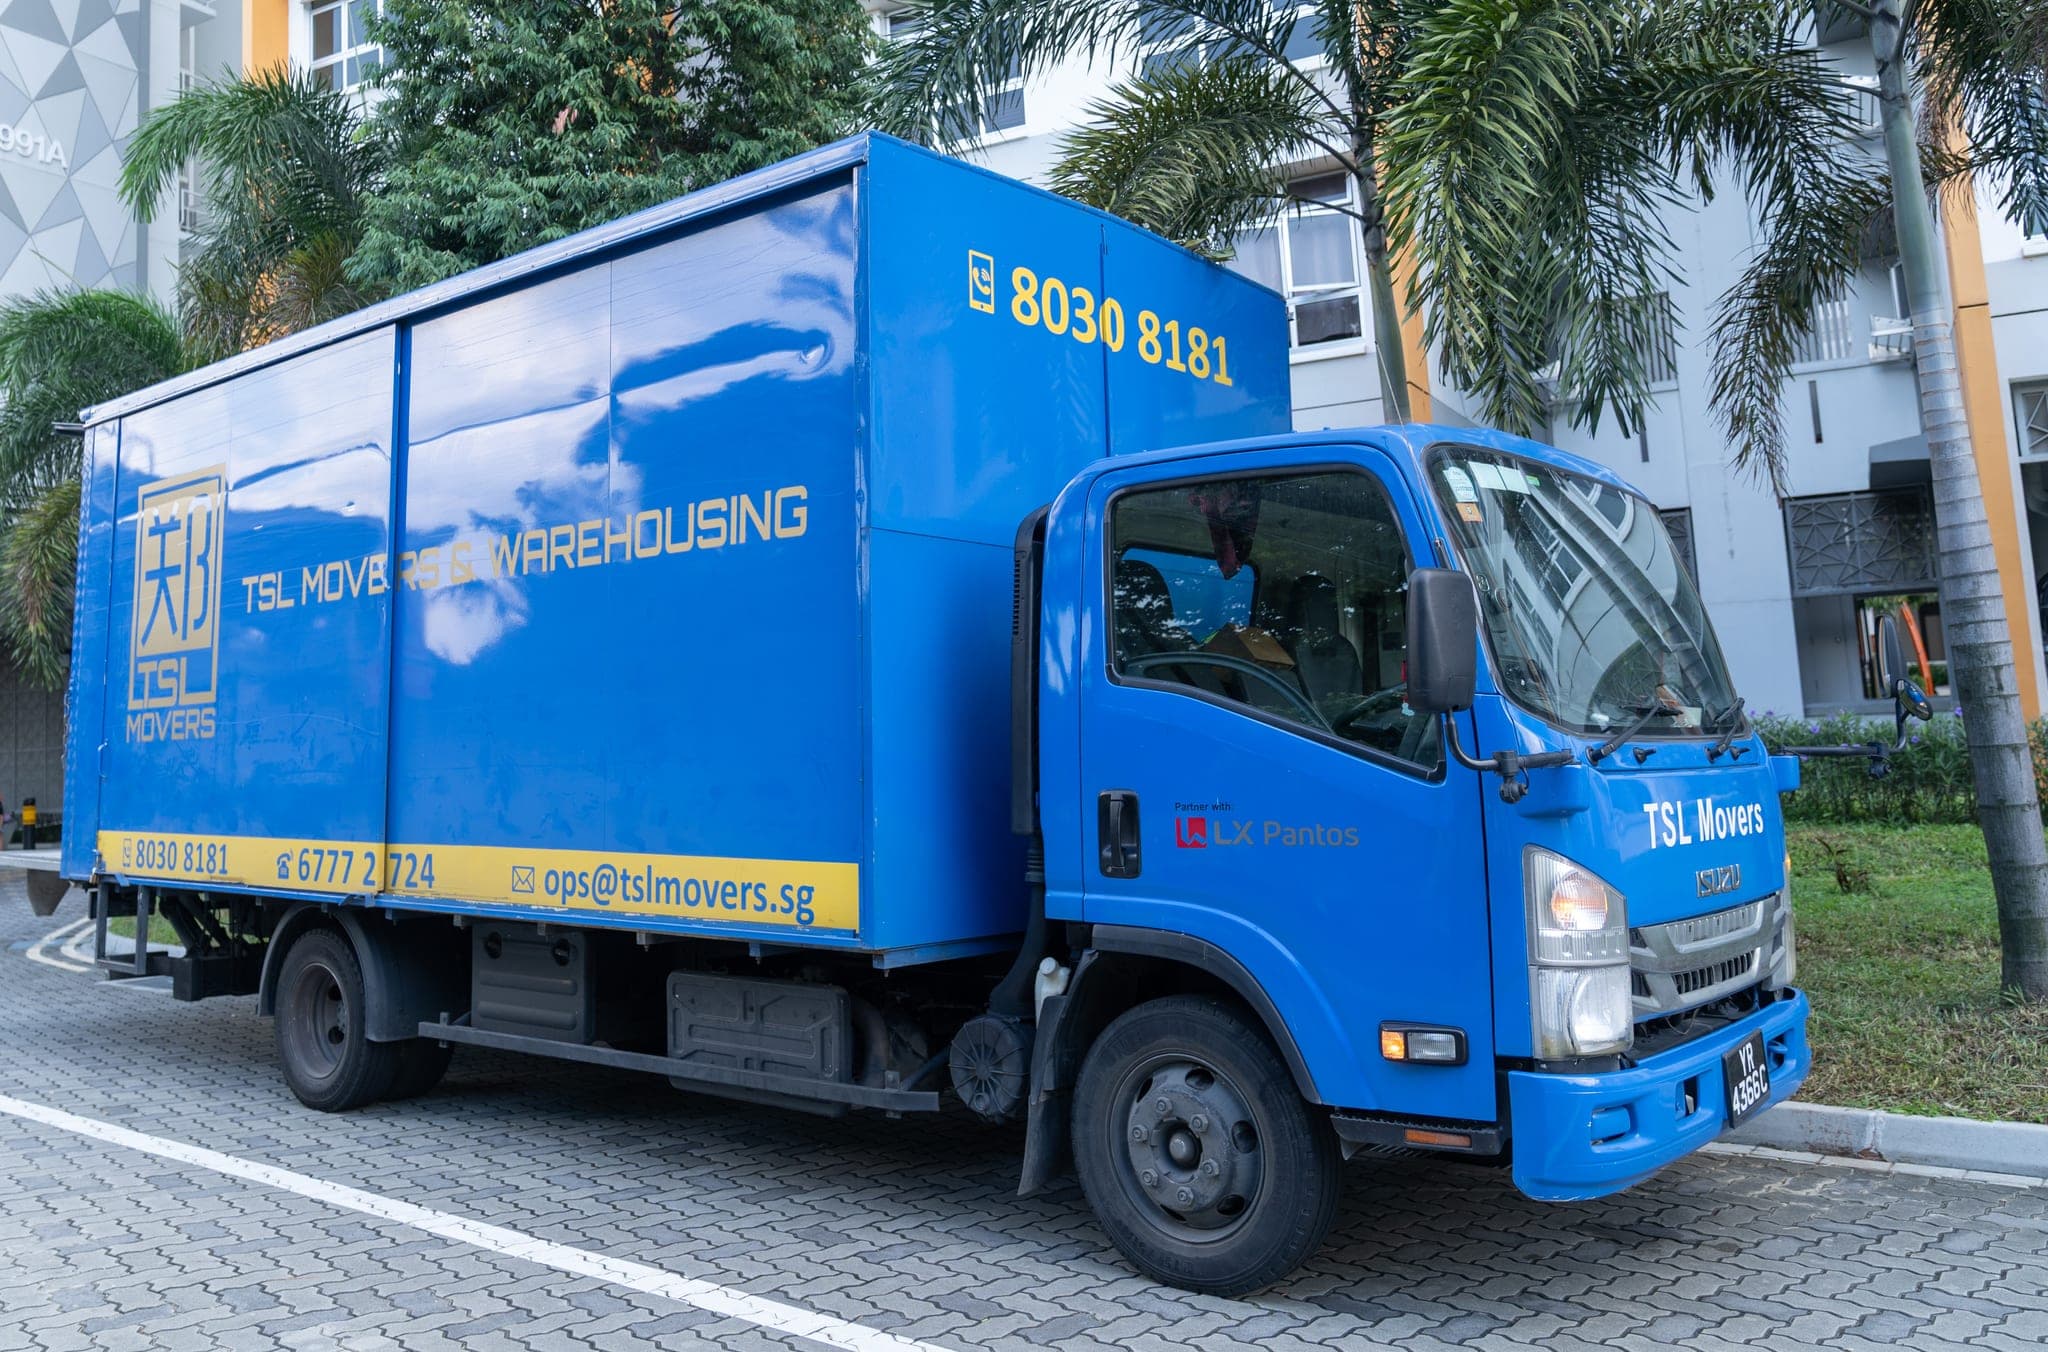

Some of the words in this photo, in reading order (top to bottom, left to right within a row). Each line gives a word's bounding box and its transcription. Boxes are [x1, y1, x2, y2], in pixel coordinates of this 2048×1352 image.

[0, 124, 67, 169] 991A
[1011, 266, 1125, 352] 8030
[1138, 310, 1233, 387] 8181
[242, 572, 295, 613] TSL
[302, 546, 440, 606] MOVERS
[450, 541, 476, 584] &
[488, 485, 808, 578] WAREHOUSING
[136, 656, 216, 709] TSL
[126, 707, 216, 744] MOVERS
[1175, 802, 1208, 812] Partner
[1212, 801, 1231, 812] with
[1643, 800, 1692, 849] TSL
[1697, 797, 1764, 842] Movers
[1214, 820, 1254, 845] LX
[1264, 820, 1360, 847] Pantos
[136, 839, 178, 871] 8030
[184, 842, 228, 875] 8181
[298, 848, 354, 884] 6777
[544, 863, 815, 926] ops@tslmovers.sg
[1695, 863, 1741, 898] ISUZU
[1738, 1042, 1755, 1076] YR
[1732, 1063, 1768, 1115] 4366C
